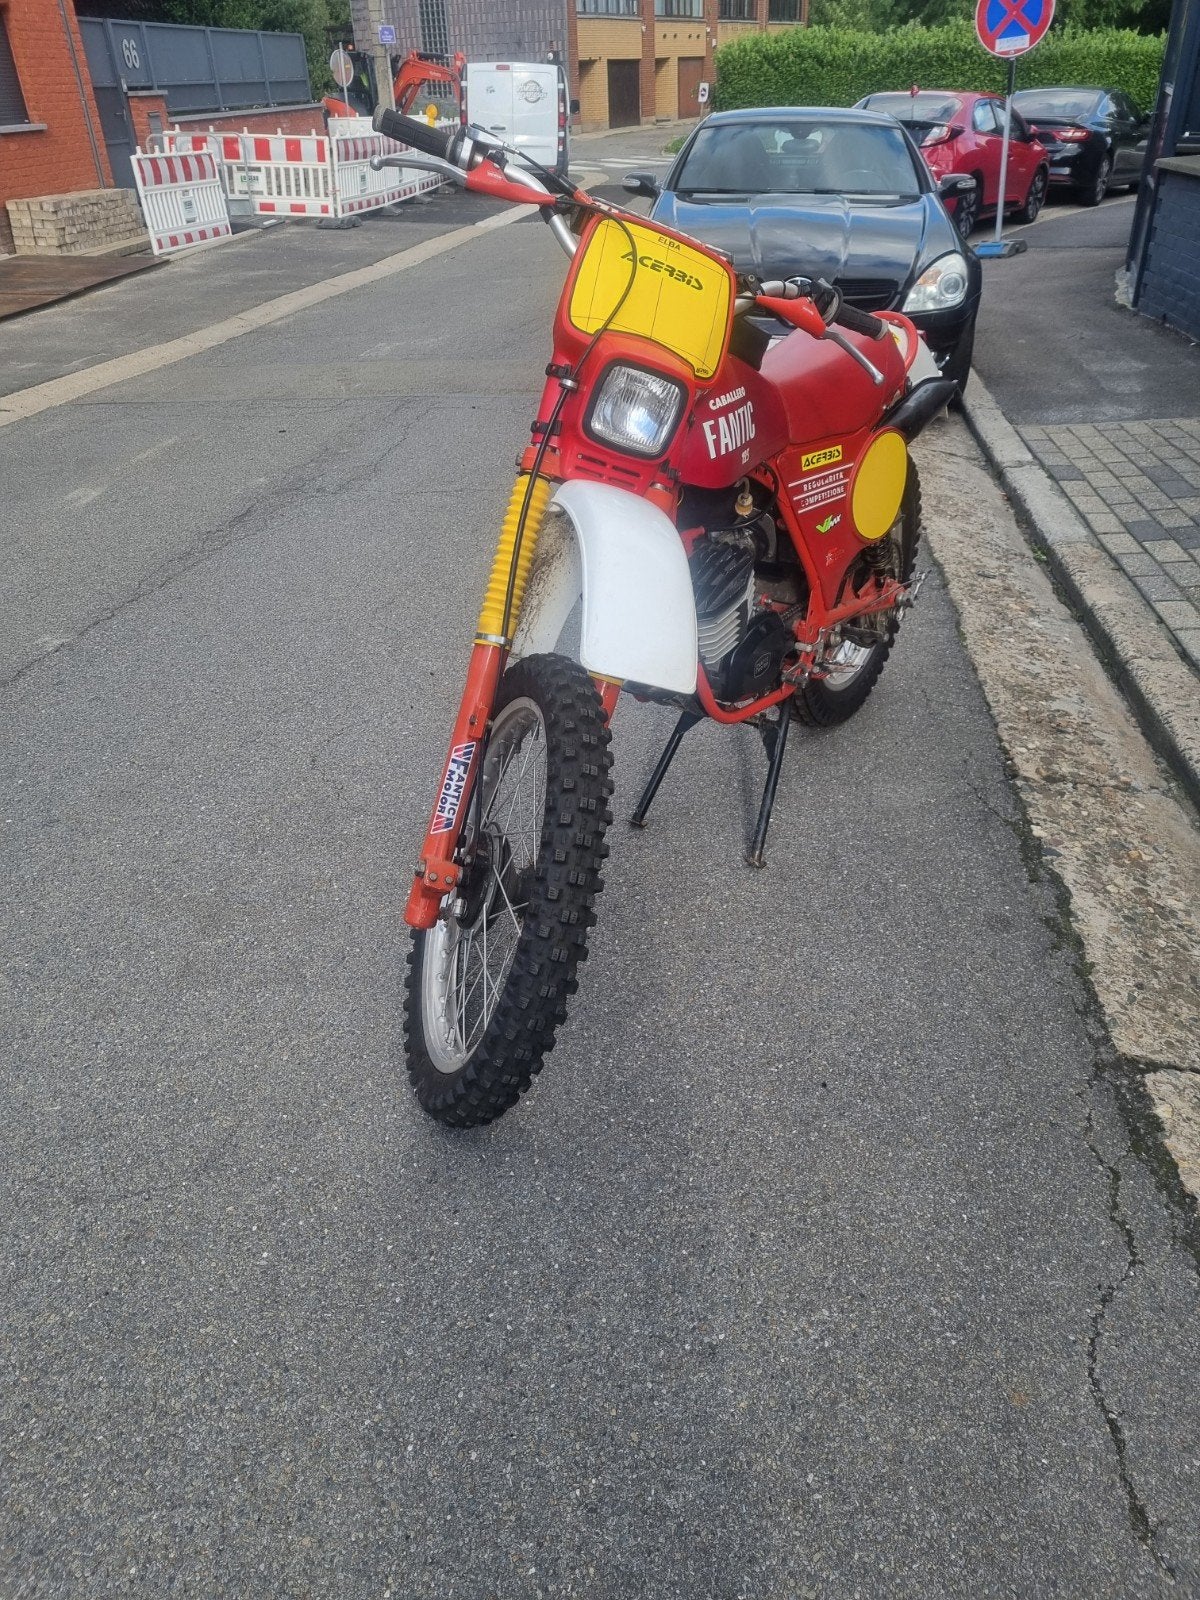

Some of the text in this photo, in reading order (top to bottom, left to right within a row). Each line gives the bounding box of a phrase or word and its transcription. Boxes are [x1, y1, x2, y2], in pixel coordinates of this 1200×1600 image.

[122, 38, 140, 69] 66
[657, 236, 681, 251] ELBA
[620, 251, 704, 291] ACERBIS
[708, 386, 746, 411] CABALLERO
[702, 401, 756, 460] FANTIC
[803, 448, 841, 468] ACERBIS
[800, 485, 844, 507] COMPETIZIONE
[437, 769, 456, 814] MOTOR
[447, 758, 471, 816] FANTIC
